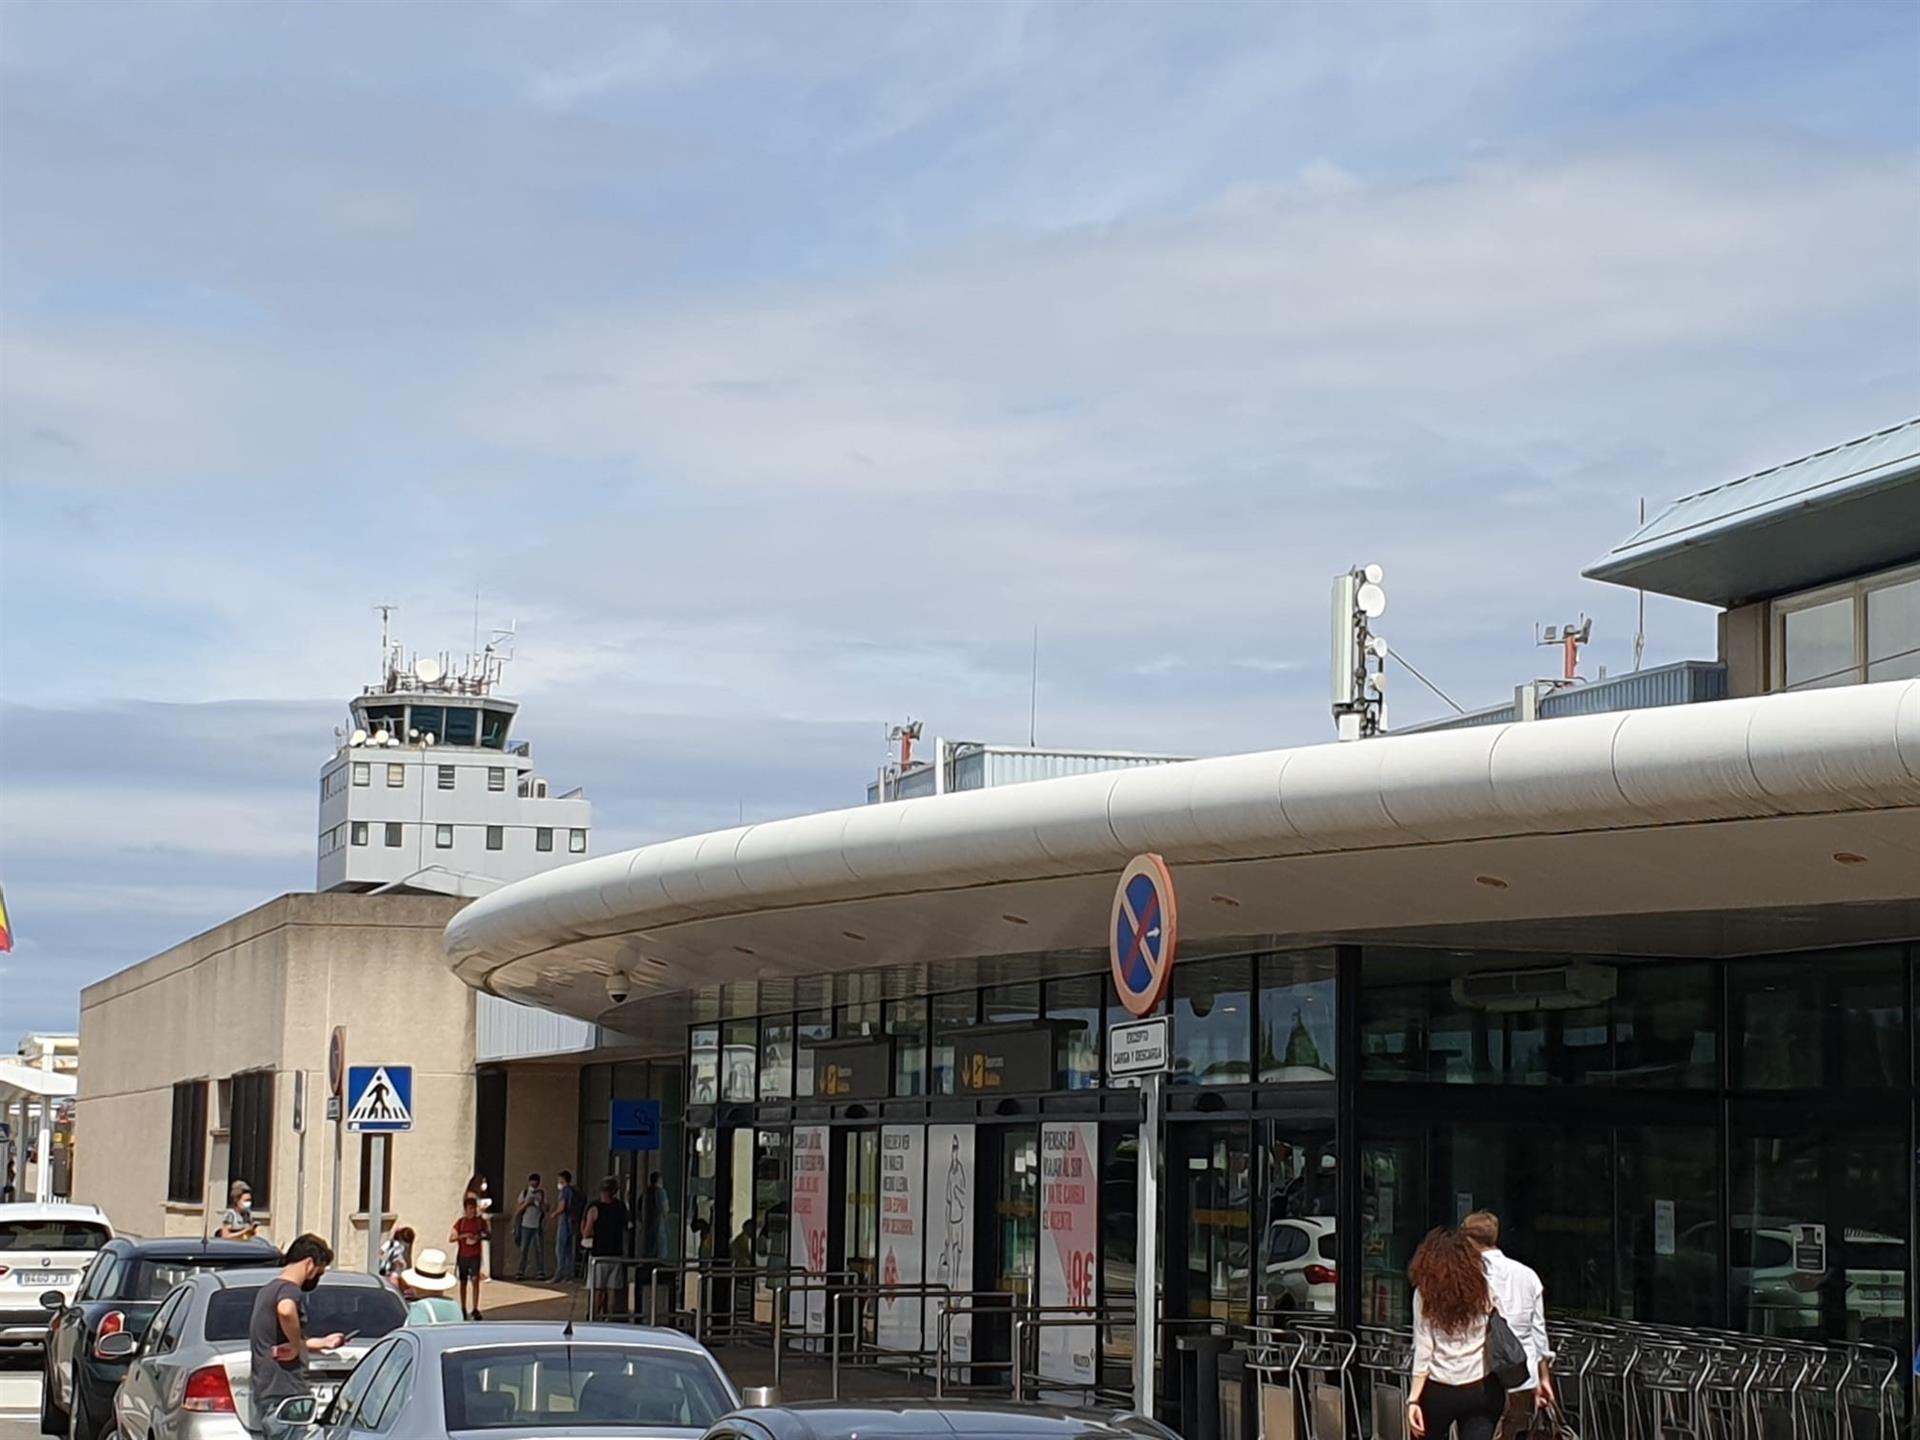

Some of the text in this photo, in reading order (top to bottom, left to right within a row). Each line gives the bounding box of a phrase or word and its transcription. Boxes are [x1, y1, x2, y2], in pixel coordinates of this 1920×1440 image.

[1126, 1030, 1149, 1044] EXCEPTO
[1113, 1051, 1131, 1065] CARGA
[1135, 1047, 1162, 1062] DESCARGA
